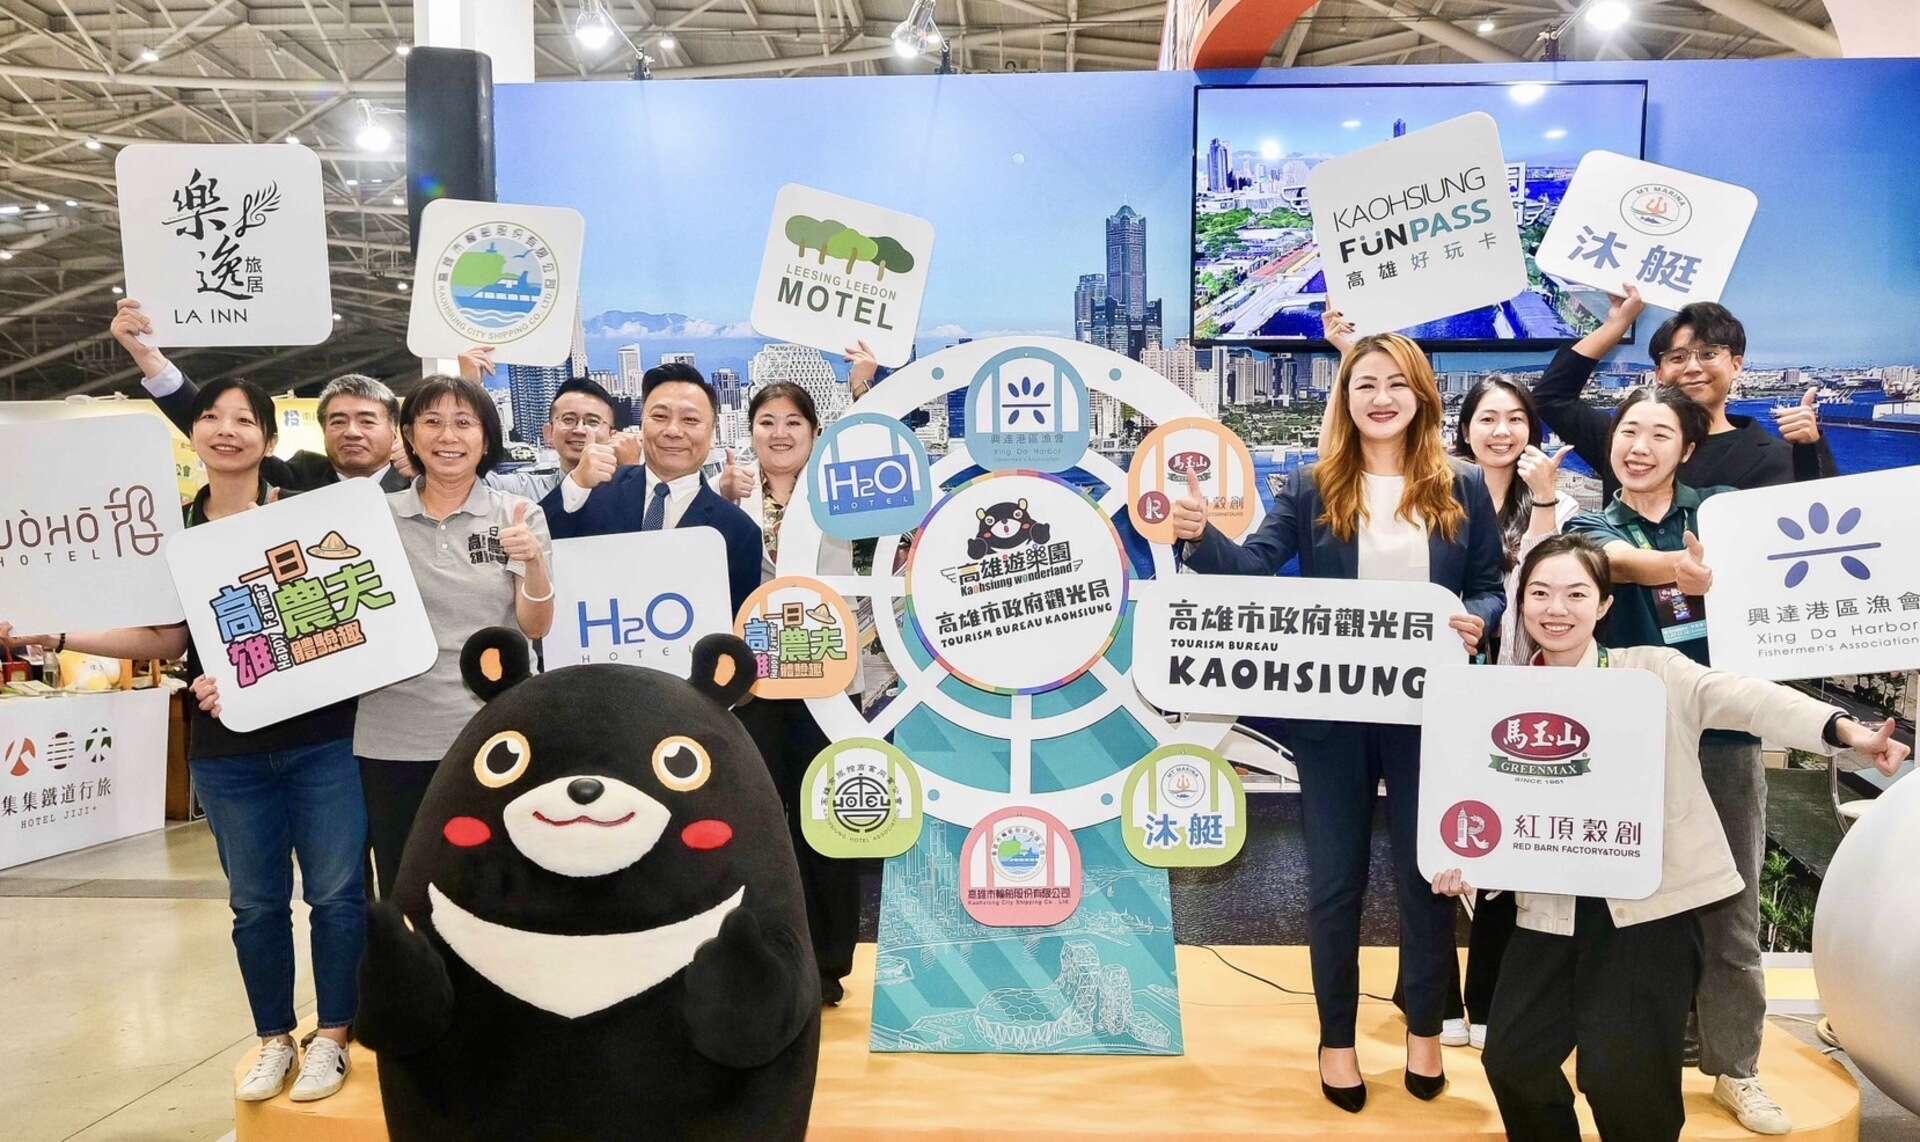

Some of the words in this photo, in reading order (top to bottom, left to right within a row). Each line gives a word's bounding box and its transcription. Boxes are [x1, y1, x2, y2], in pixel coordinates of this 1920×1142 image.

[1333, 167, 1486, 232] KAOHSIUNG
[245, 256, 264, 293] 旅居
[1346, 231, 1497, 290] 高雄好玩卡
[1568, 225, 1702, 293] 沐艇
[786, 264, 841, 286] LEESING
[846, 278, 897, 301] LEEDON
[174, 309, 202, 324] LA
[211, 308, 249, 324] INN
[777, 277, 894, 331] MOTEL
[833, 496, 909, 511] HOTEL
[960, 575, 1013, 597] Kaohsiung
[1014, 562, 1073, 584] wonderland
[252, 584, 279, 629] Farmer
[272, 560, 395, 641] 農夫
[936, 578, 1111, 635] 高雄市政府觀光局
[1748, 591, 1920, 626] 興達港區漁會
[940, 629, 993, 648] TOURISM
[995, 618, 1043, 637] BUREAU
[1045, 602, 1113, 625] KAOHSIUNG
[1168, 599, 1434, 641] 高雄市政府觀光局
[1756, 632, 1797, 645] Xing
[1810, 628, 1837, 640] Da
[1851, 621, 1918, 637] Harbor
[268, 632, 293, 671] Happy
[1170, 638, 1225, 650] TOURISM
[1228, 640, 1279, 652] BUREAU
[1758, 643, 1834, 657] Fishermen's
[1839, 636, 1919, 651] Association
[1168, 655, 1427, 699] KAOHSIUNG
[1503, 718, 1583, 750] 馬玉山
[1500, 762, 1578, 776] GREENMAX
[21, 815, 57, 829] HOTEL
[1146, 813, 1223, 847] 沐艇
[1513, 814, 1642, 845] 紅頂穀創
[1512, 842, 1532, 850] RED
[1533, 843, 1559, 852] BARN
